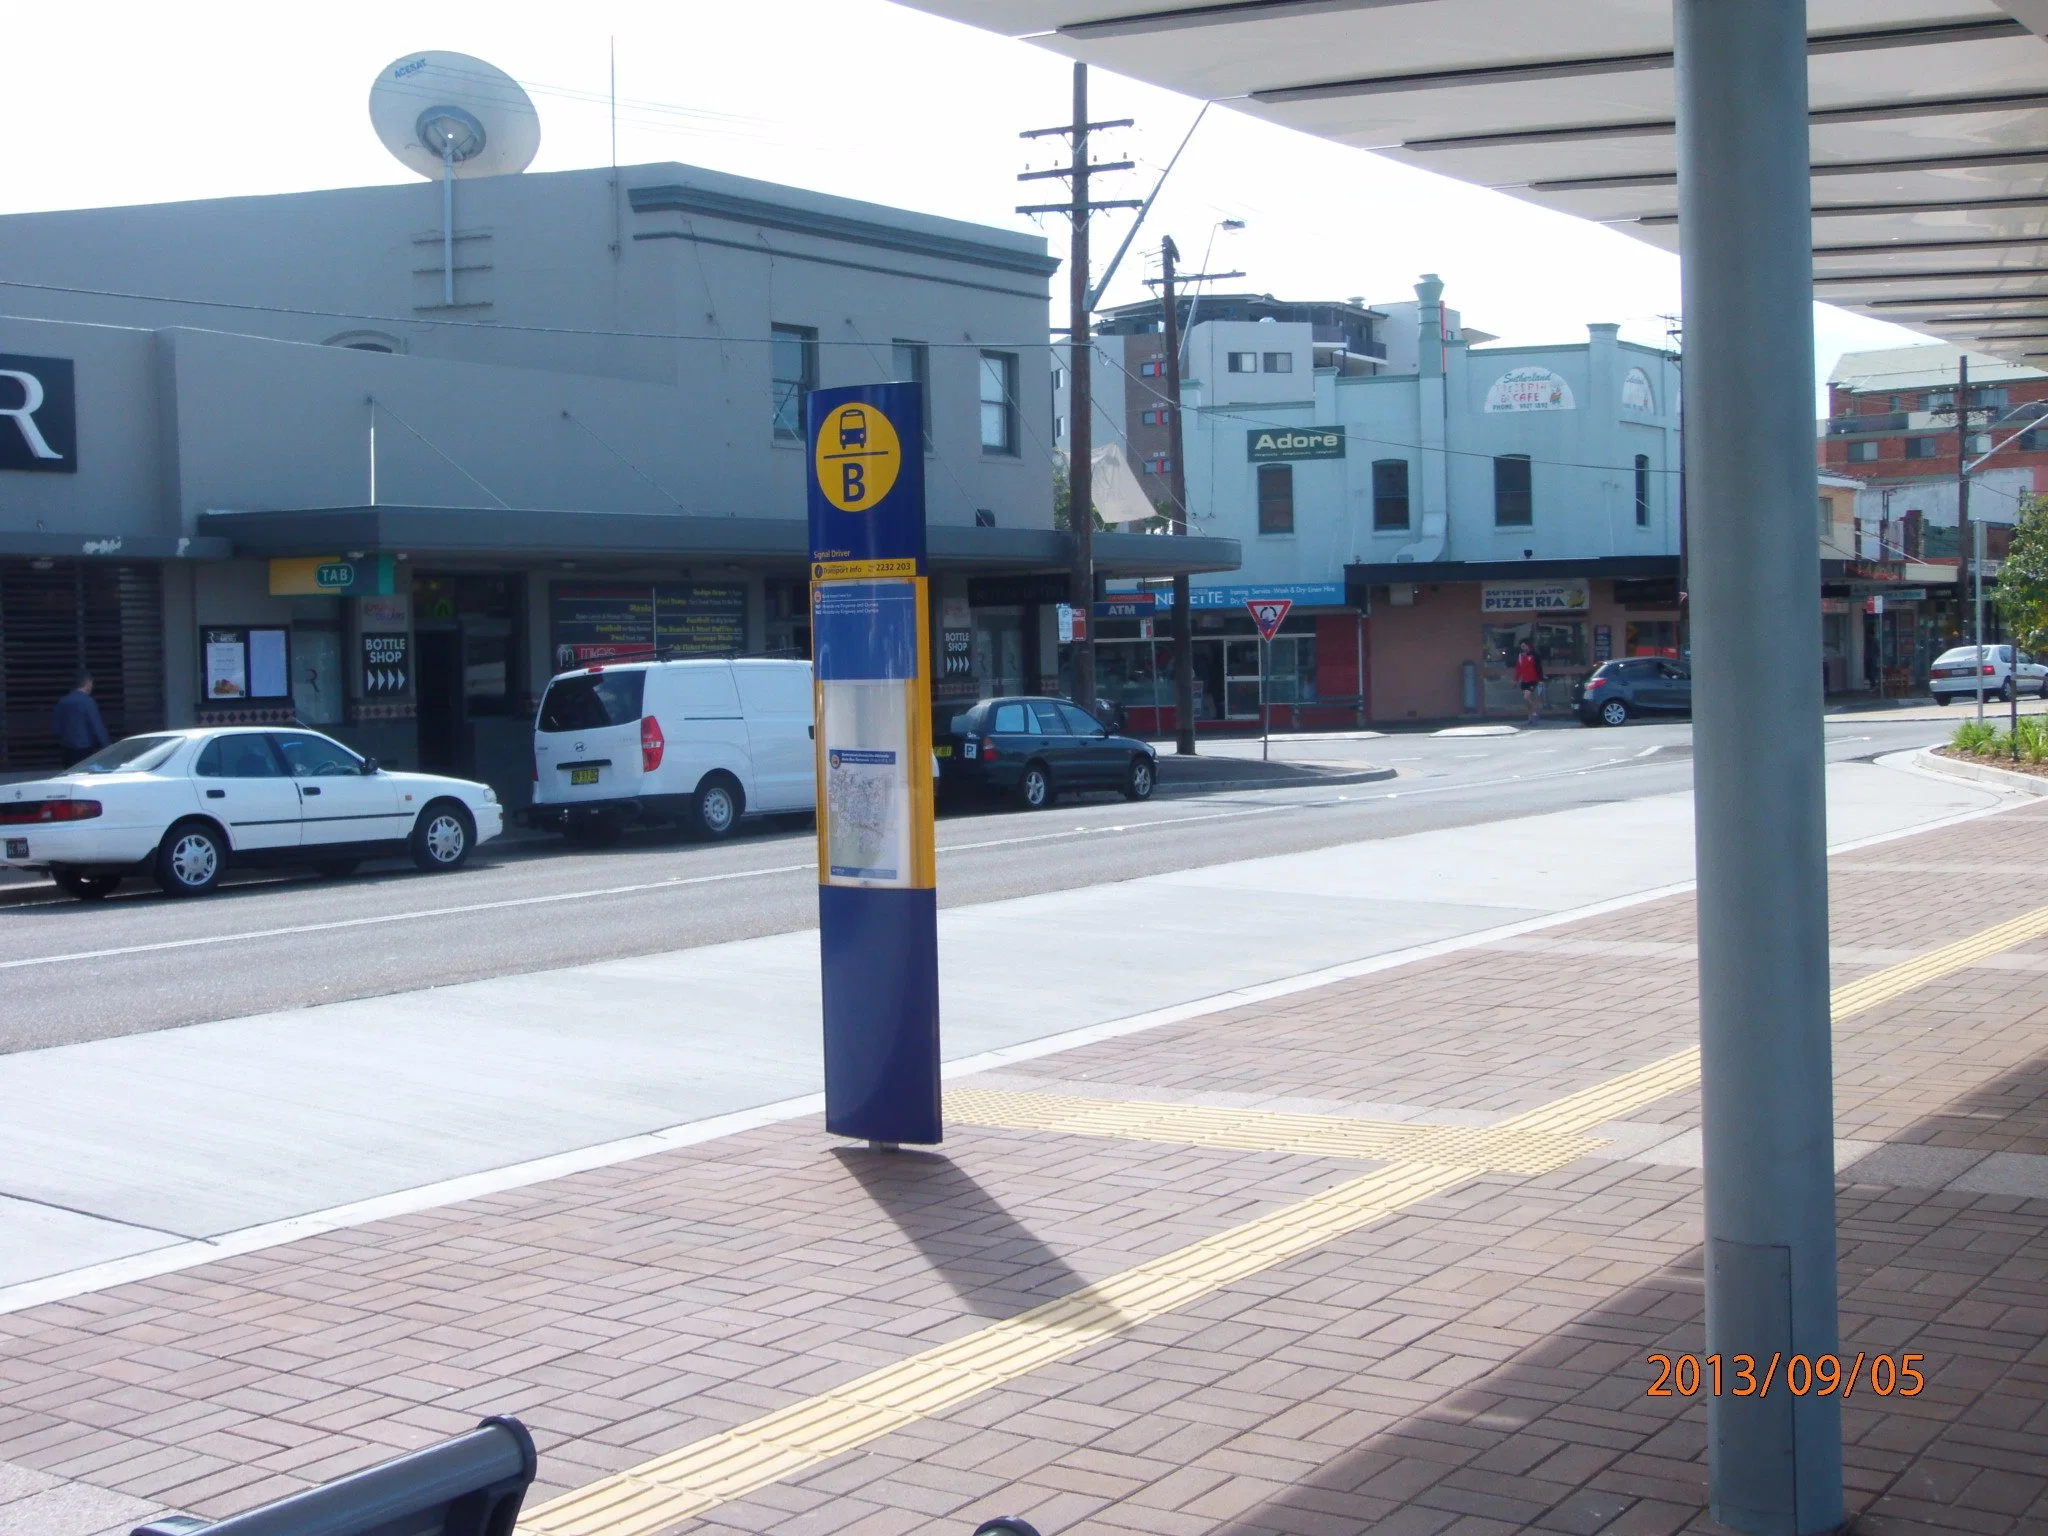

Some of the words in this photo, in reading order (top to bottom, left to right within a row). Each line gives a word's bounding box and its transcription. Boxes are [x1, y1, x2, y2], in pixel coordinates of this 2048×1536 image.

[1503, 372, 1552, 383] Sutherland
[1513, 393, 1540, 402] CAFE
[0, 371, 63, 459] R
[1255, 433, 1338, 449] Adore
[843, 463, 865, 502] B
[813, 550, 830, 560] Signal
[831, 549, 851, 558] Driver
[823, 567, 848, 575] Transport
[876, 563, 894, 572] 2232
[896, 562, 911, 571] 203
[322, 568, 348, 582] TAB
[1273, 586, 1289, 594] Wash
[1296, 586, 1306, 594] Dry
[1230, 597, 1241, 605] Dry
[1486, 596, 1566, 609] PIZZERIA
[1108, 605, 1137, 616] ATM
[945, 632, 970, 643] BOTTLE
[365, 638, 406, 651] BOTTLE
[948, 642, 968, 652] SHOP
[369, 651, 402, 664] SHOP
[967, 745, 974, 757] P
